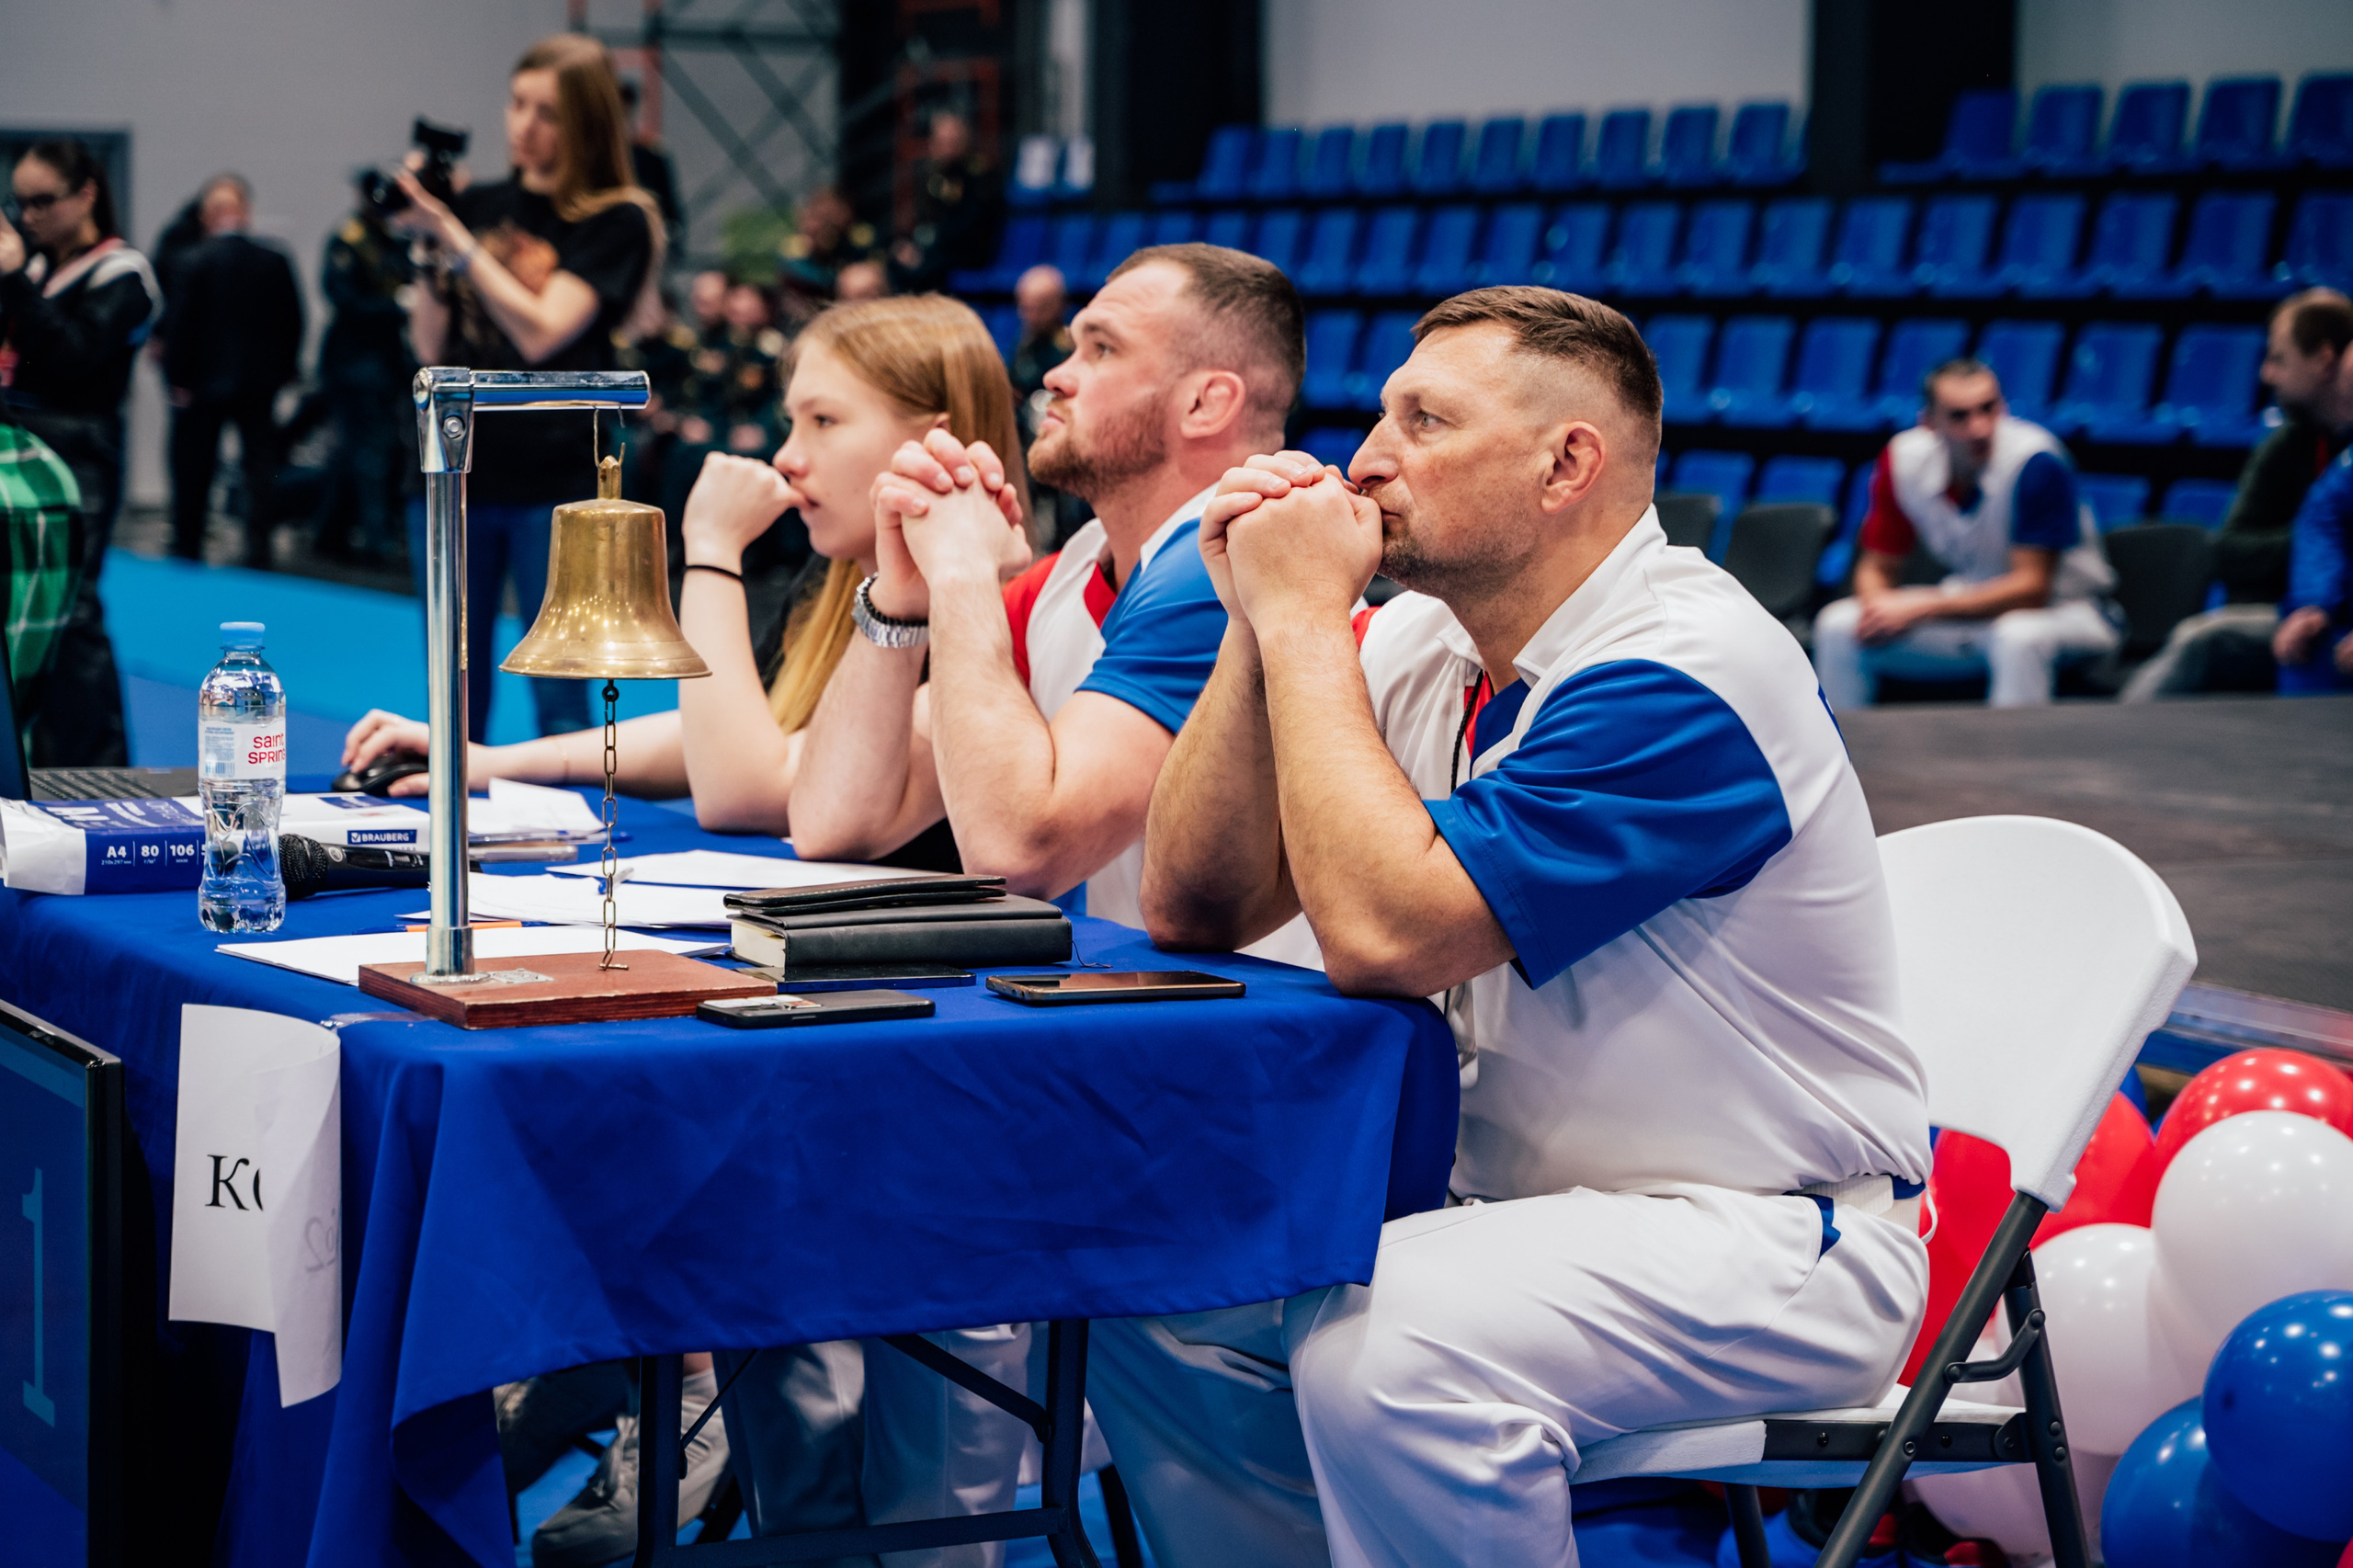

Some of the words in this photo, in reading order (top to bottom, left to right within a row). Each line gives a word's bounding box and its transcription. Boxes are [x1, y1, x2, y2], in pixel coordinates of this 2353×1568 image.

[361, 832, 410, 842] BRAUBERG
[107, 846, 127, 858] A4
[141, 845, 160, 858] 80
[169, 844, 195, 857] 106
